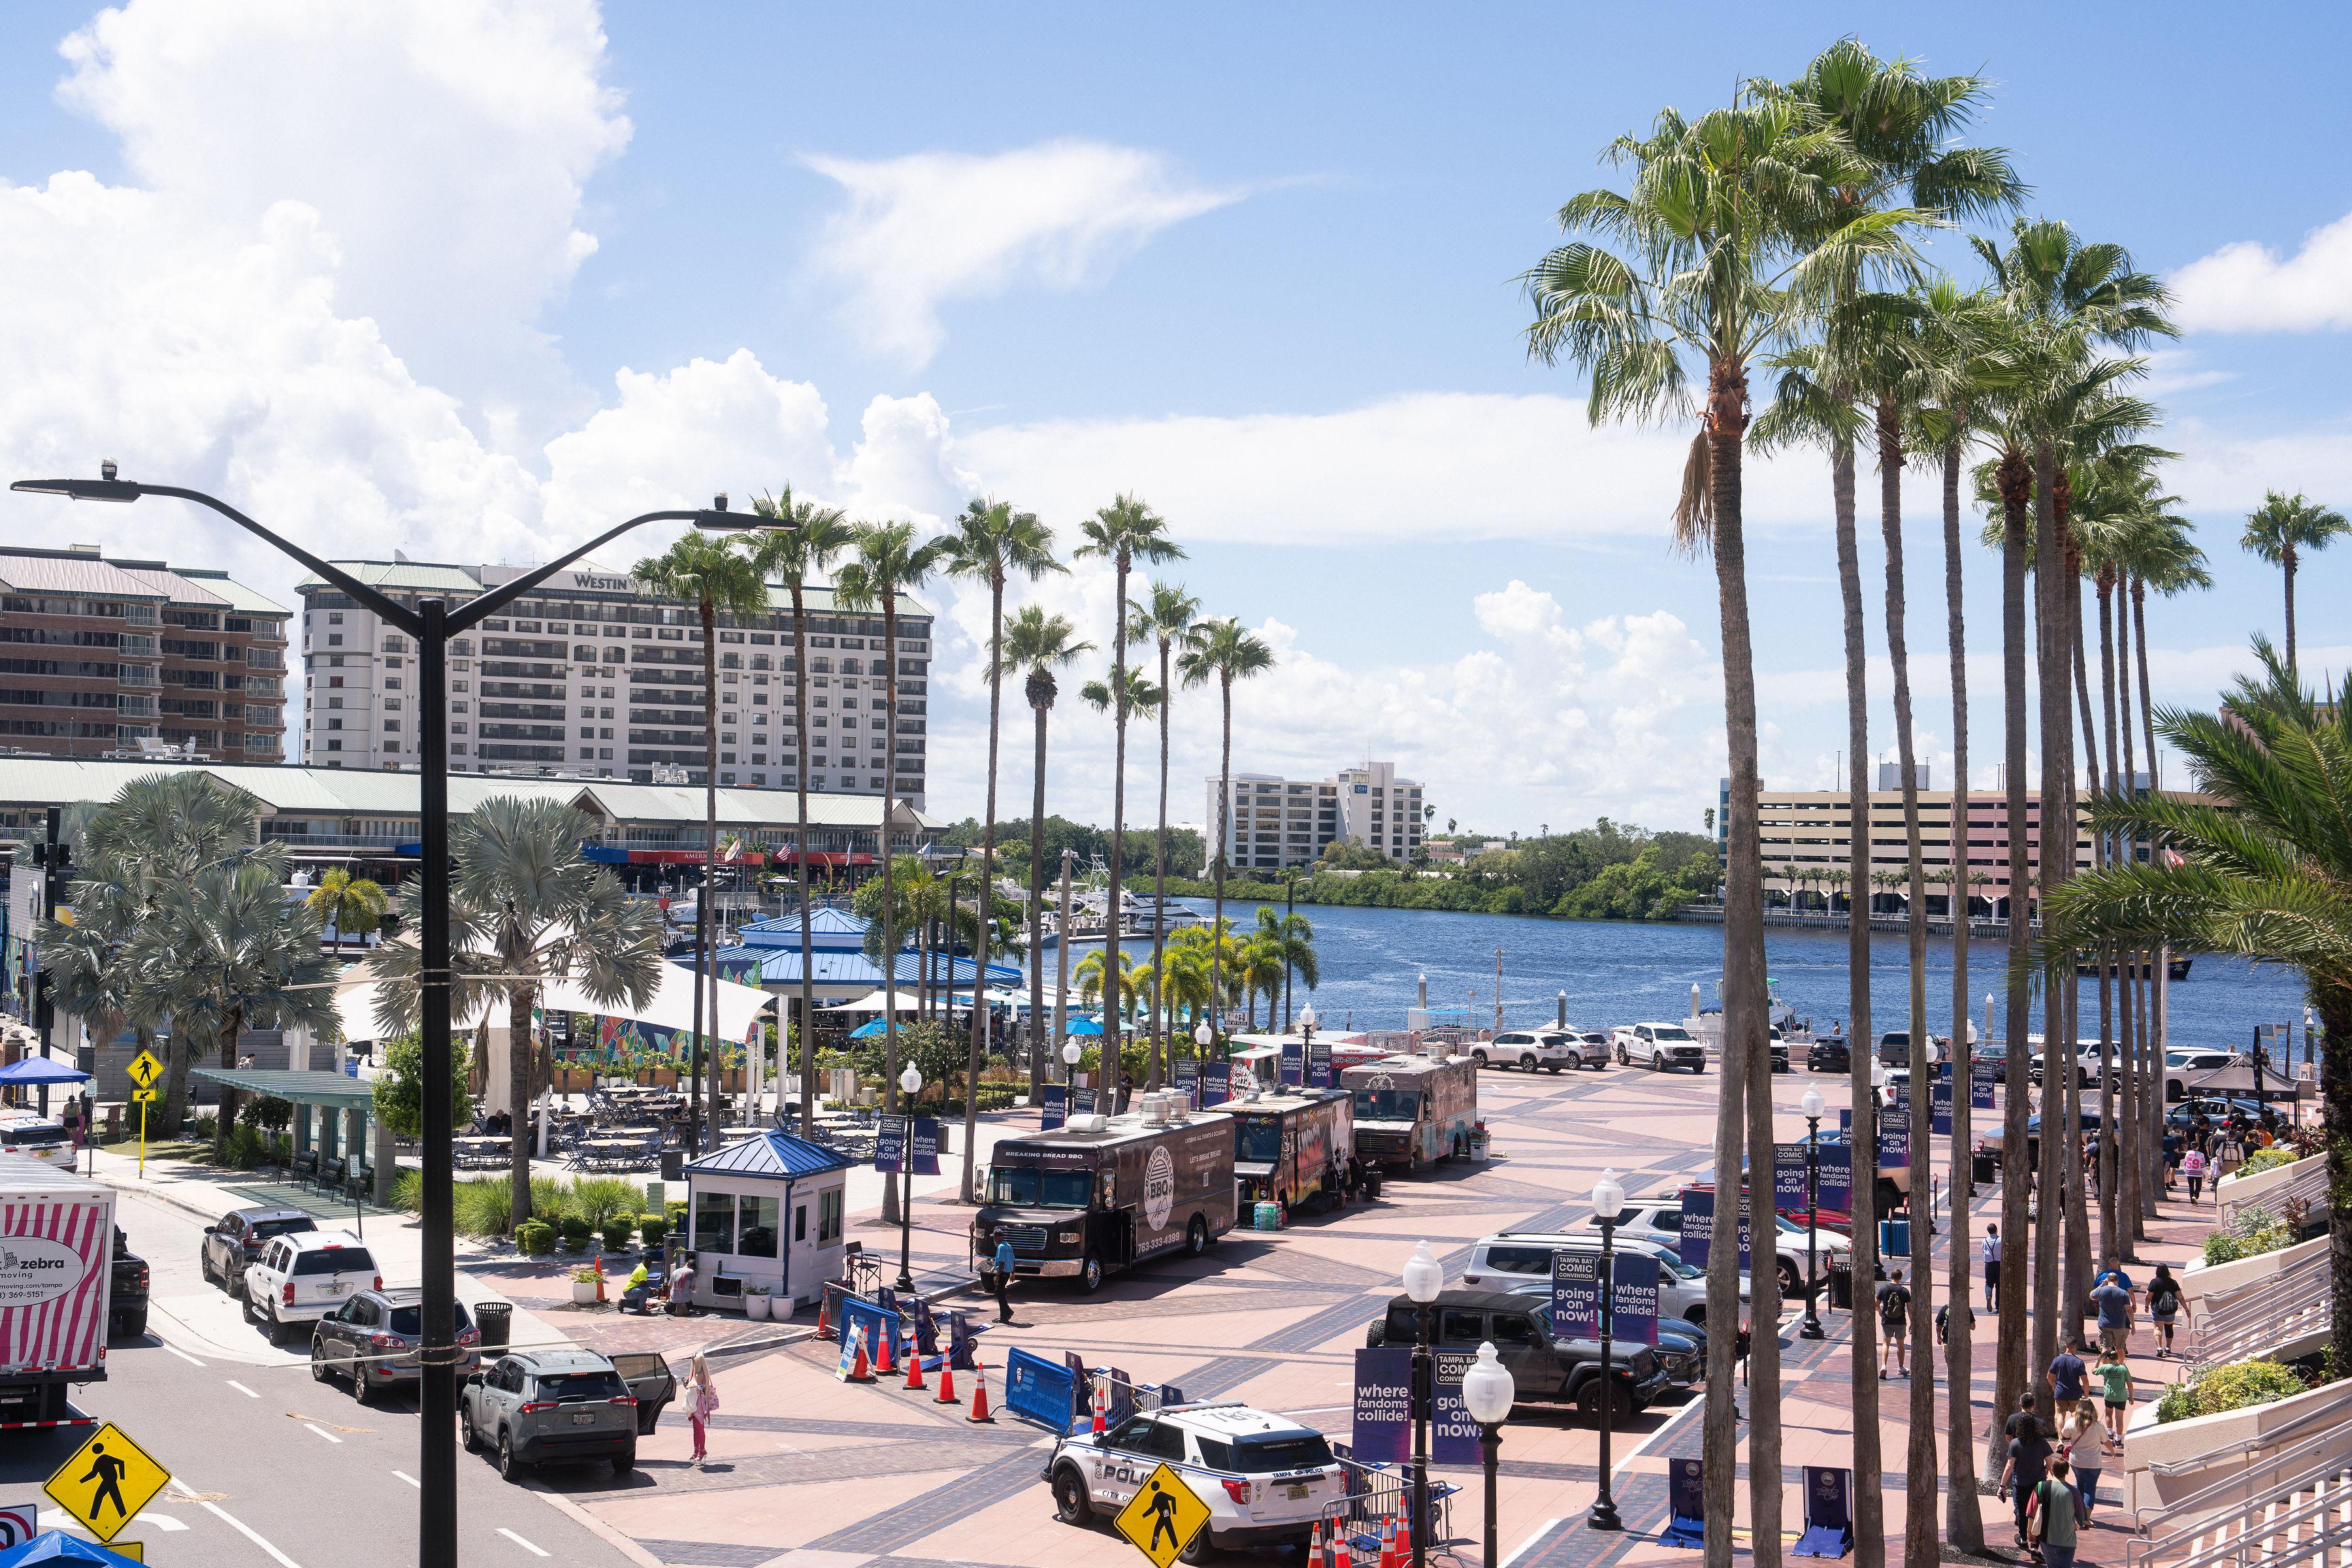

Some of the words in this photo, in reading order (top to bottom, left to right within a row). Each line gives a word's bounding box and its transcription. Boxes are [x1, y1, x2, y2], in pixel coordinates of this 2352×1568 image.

[574, 574, 627, 590] WESTIN
[2202, 1090, 2281, 1099] TESA
[879, 1137, 902, 1147] going
[1882, 1132, 1906, 1141] going
[1882, 1145, 1906, 1154] now!
[877, 1152, 900, 1160] now!
[1190, 1155, 1199, 1164] LET'S
[1199, 1152, 1210, 1162] BREAK
[1210, 1149, 1222, 1158] BREAD!
[1145, 1148, 1162, 1188] BREAKING
[1163, 1151, 1173, 1181] BREAD
[1776, 1169, 1805, 1178] going
[1820, 1164, 1850, 1173] where
[1150, 1179, 1168, 1200] BBQ
[1776, 1184, 1805, 1193] now!
[1682, 1222, 1712, 1231] fandom
[1682, 1231, 1712, 1239] collide
[1137, 1231, 1180, 1254] 763-333-4399
[20, 1258, 65, 1269] zebra
[1559, 1264, 1593, 1273] COMIC
[1556, 1288, 1594, 1301] going
[1616, 1283, 1656, 1296] where
[1567, 1300, 1584, 1309] on
[1615, 1294, 1656, 1305] fandoms
[1556, 1309, 1594, 1322] now!
[1614, 1305, 1656, 1316] collide!
[1439, 1364, 1471, 1375] COMI
[1358, 1384, 1409, 1397] where
[1357, 1397, 1409, 1409] fandoms
[1437, 1394, 1467, 1411] goi
[1357, 1409, 1408, 1422] collide!
[1450, 1411, 1471, 1422] on
[1103, 1464, 1151, 1486] POLI
[1102, 1490, 1120, 1499] CITY
